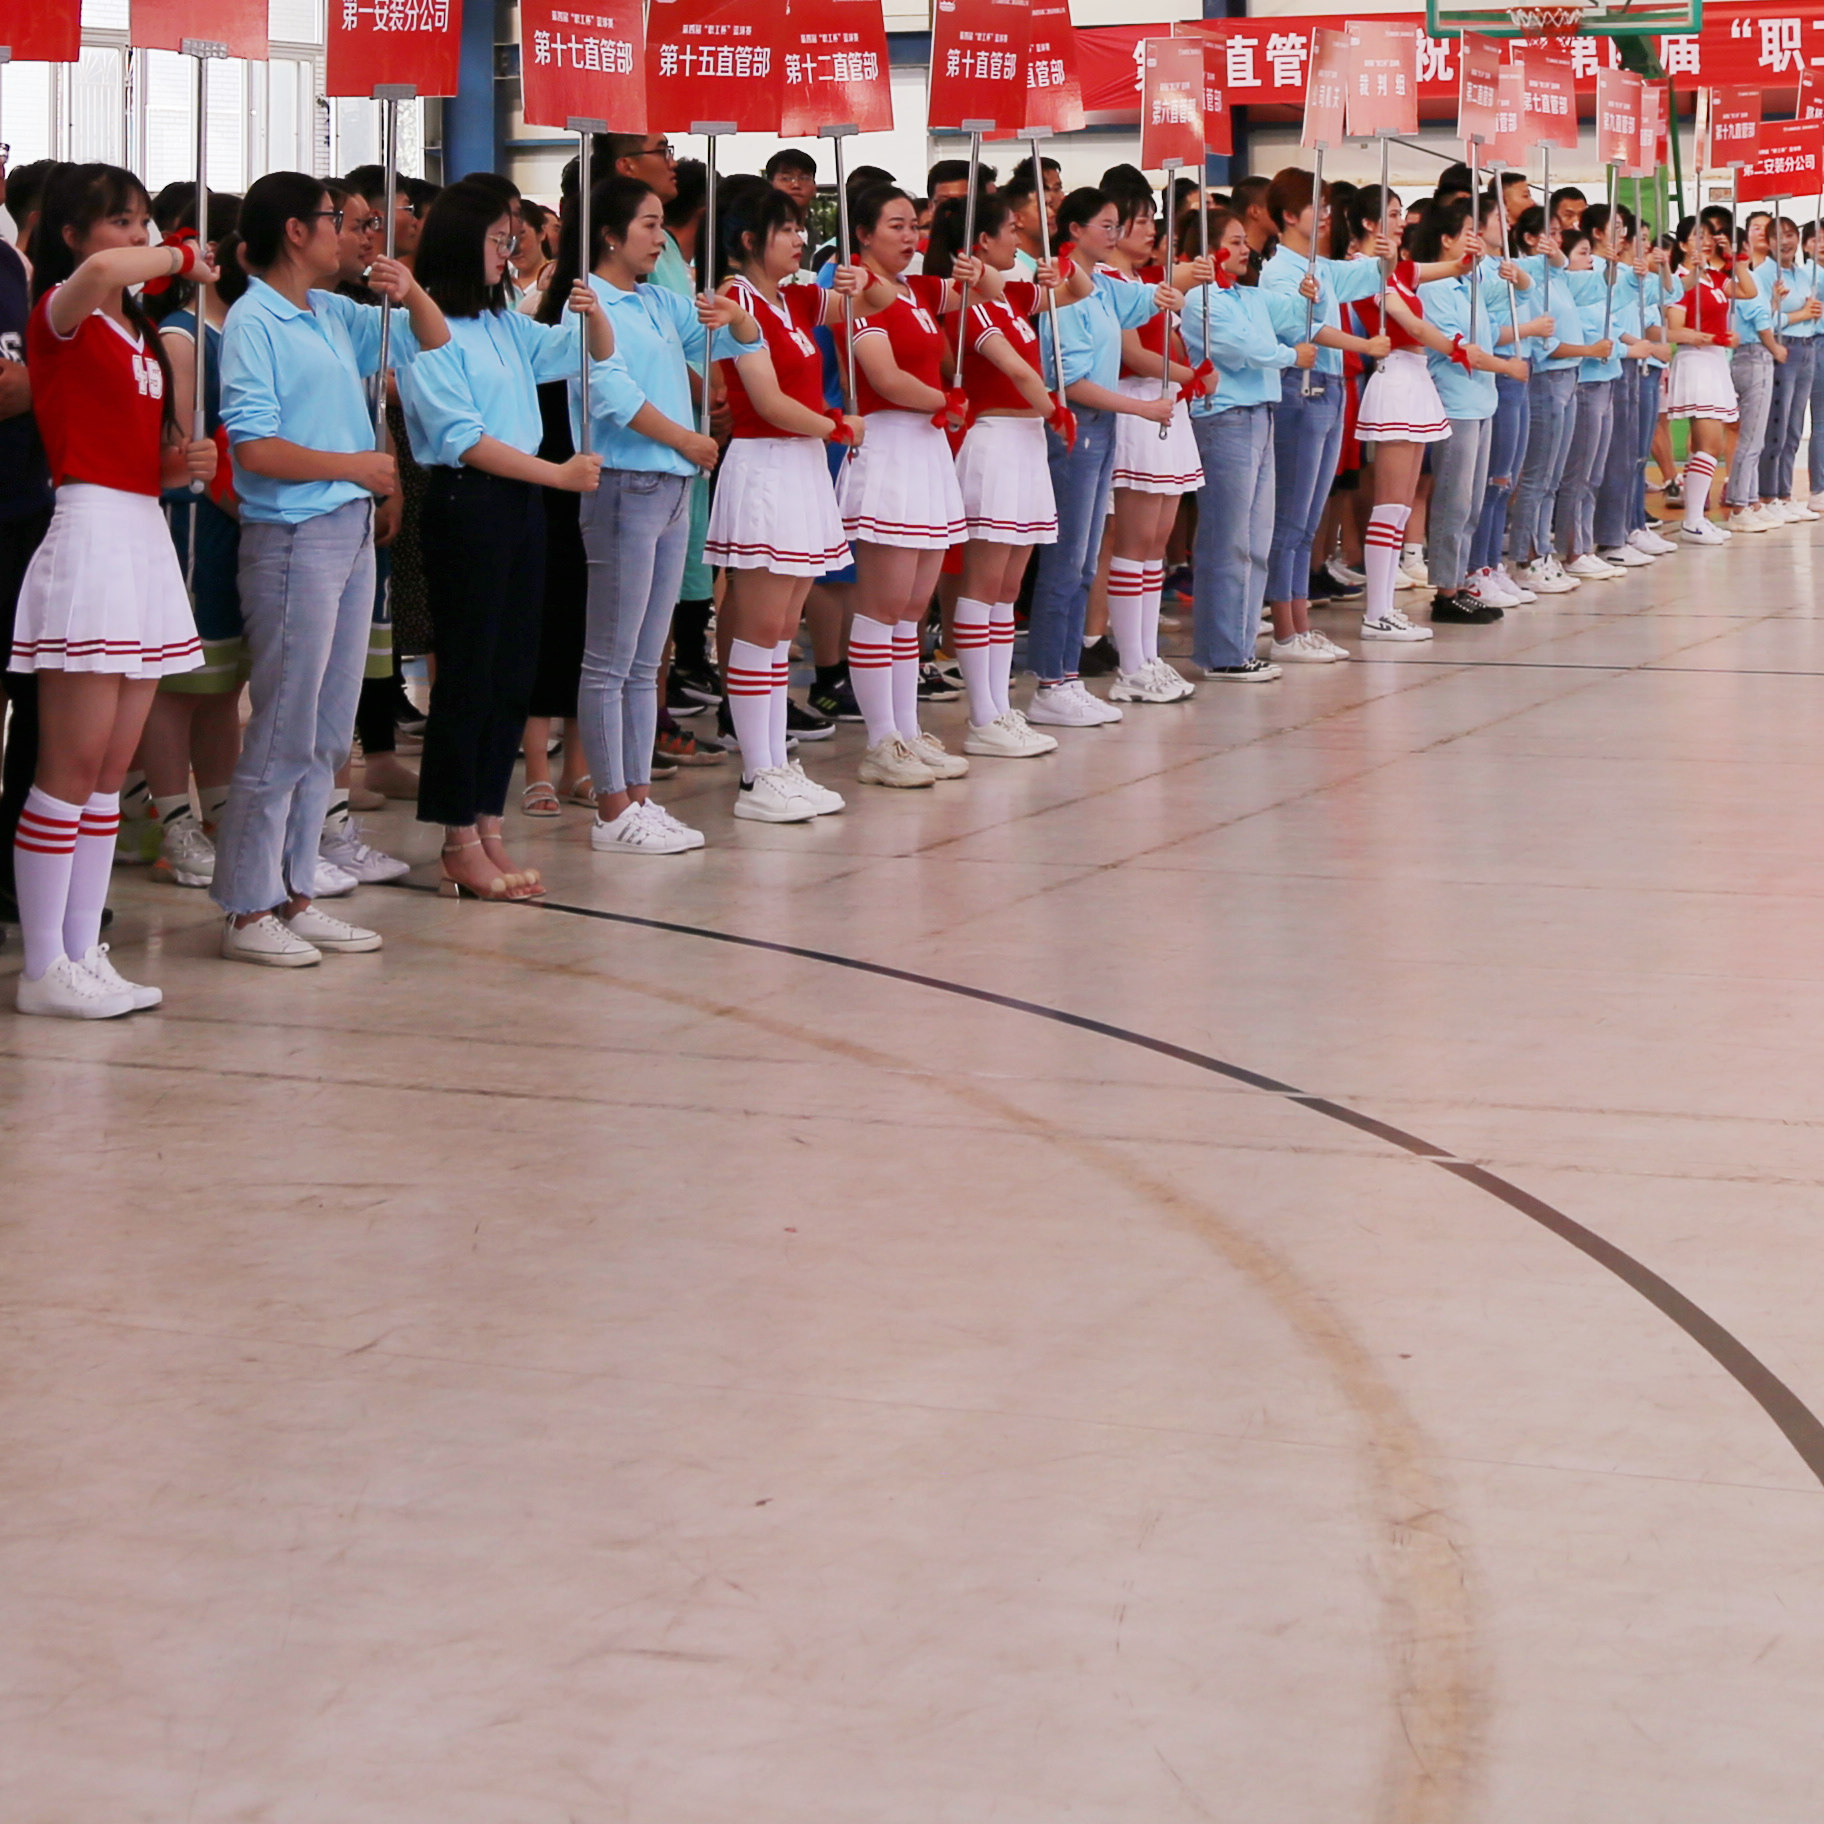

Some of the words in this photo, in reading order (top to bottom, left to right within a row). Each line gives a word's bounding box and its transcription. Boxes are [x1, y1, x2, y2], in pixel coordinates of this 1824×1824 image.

[533, 29, 635, 76] 第十七直管部
[658, 43, 772, 78] 第十五直管部
[784, 50, 879, 86] 第十二直管部
[945, 47, 1018, 81] 第十直管部
[1743, 153, 1816, 178] 第二安装分公司
